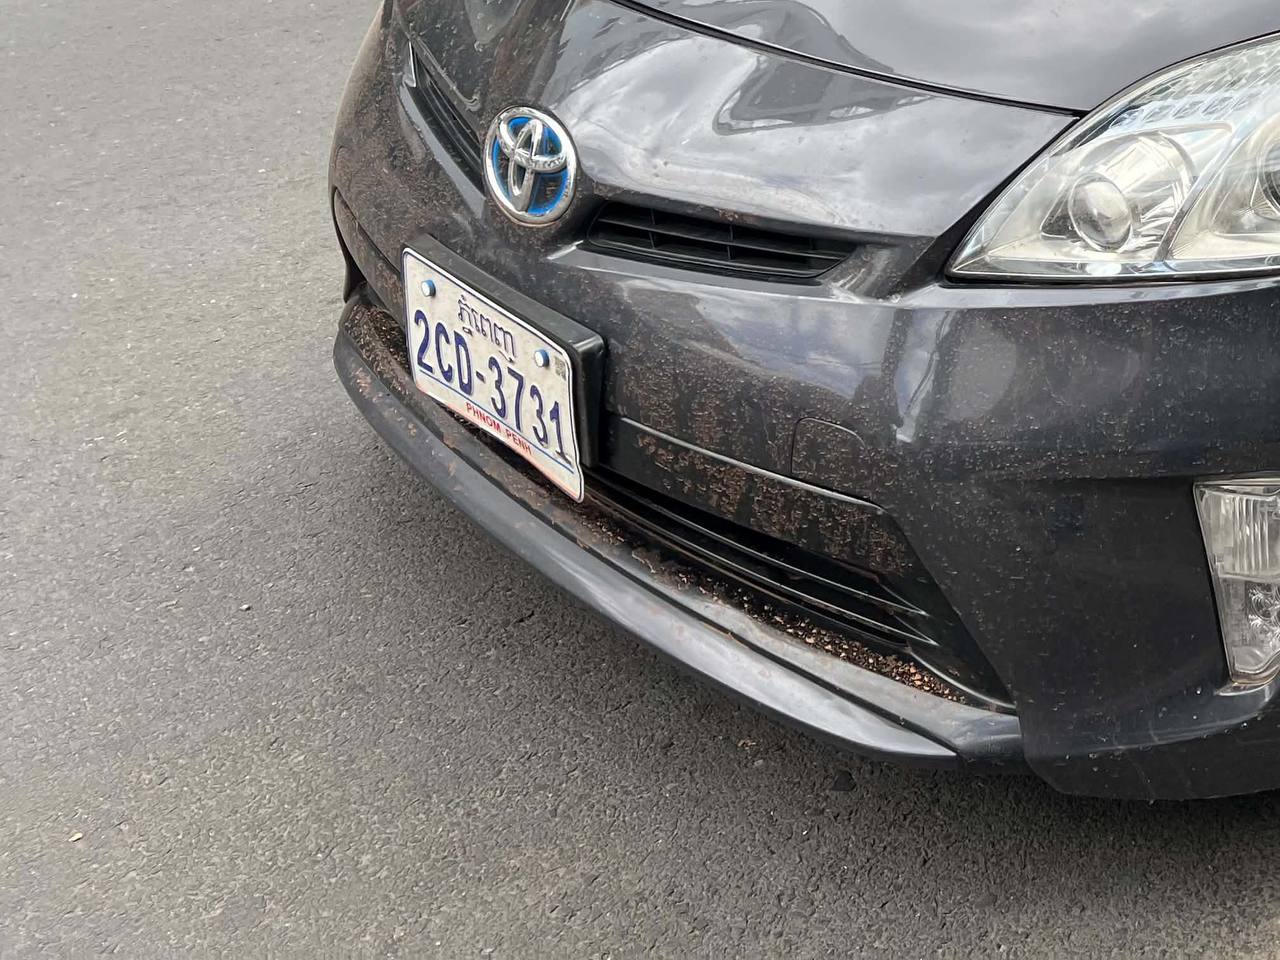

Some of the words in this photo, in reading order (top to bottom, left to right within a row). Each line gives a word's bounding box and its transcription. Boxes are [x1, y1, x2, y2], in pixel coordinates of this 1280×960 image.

[457, 293, 517, 364] ភ្នំពេញ
[413, 309, 576, 470] 2CD-3731
[465, 401, 502, 436] PHNOM
[504, 428, 534, 457] PENH
